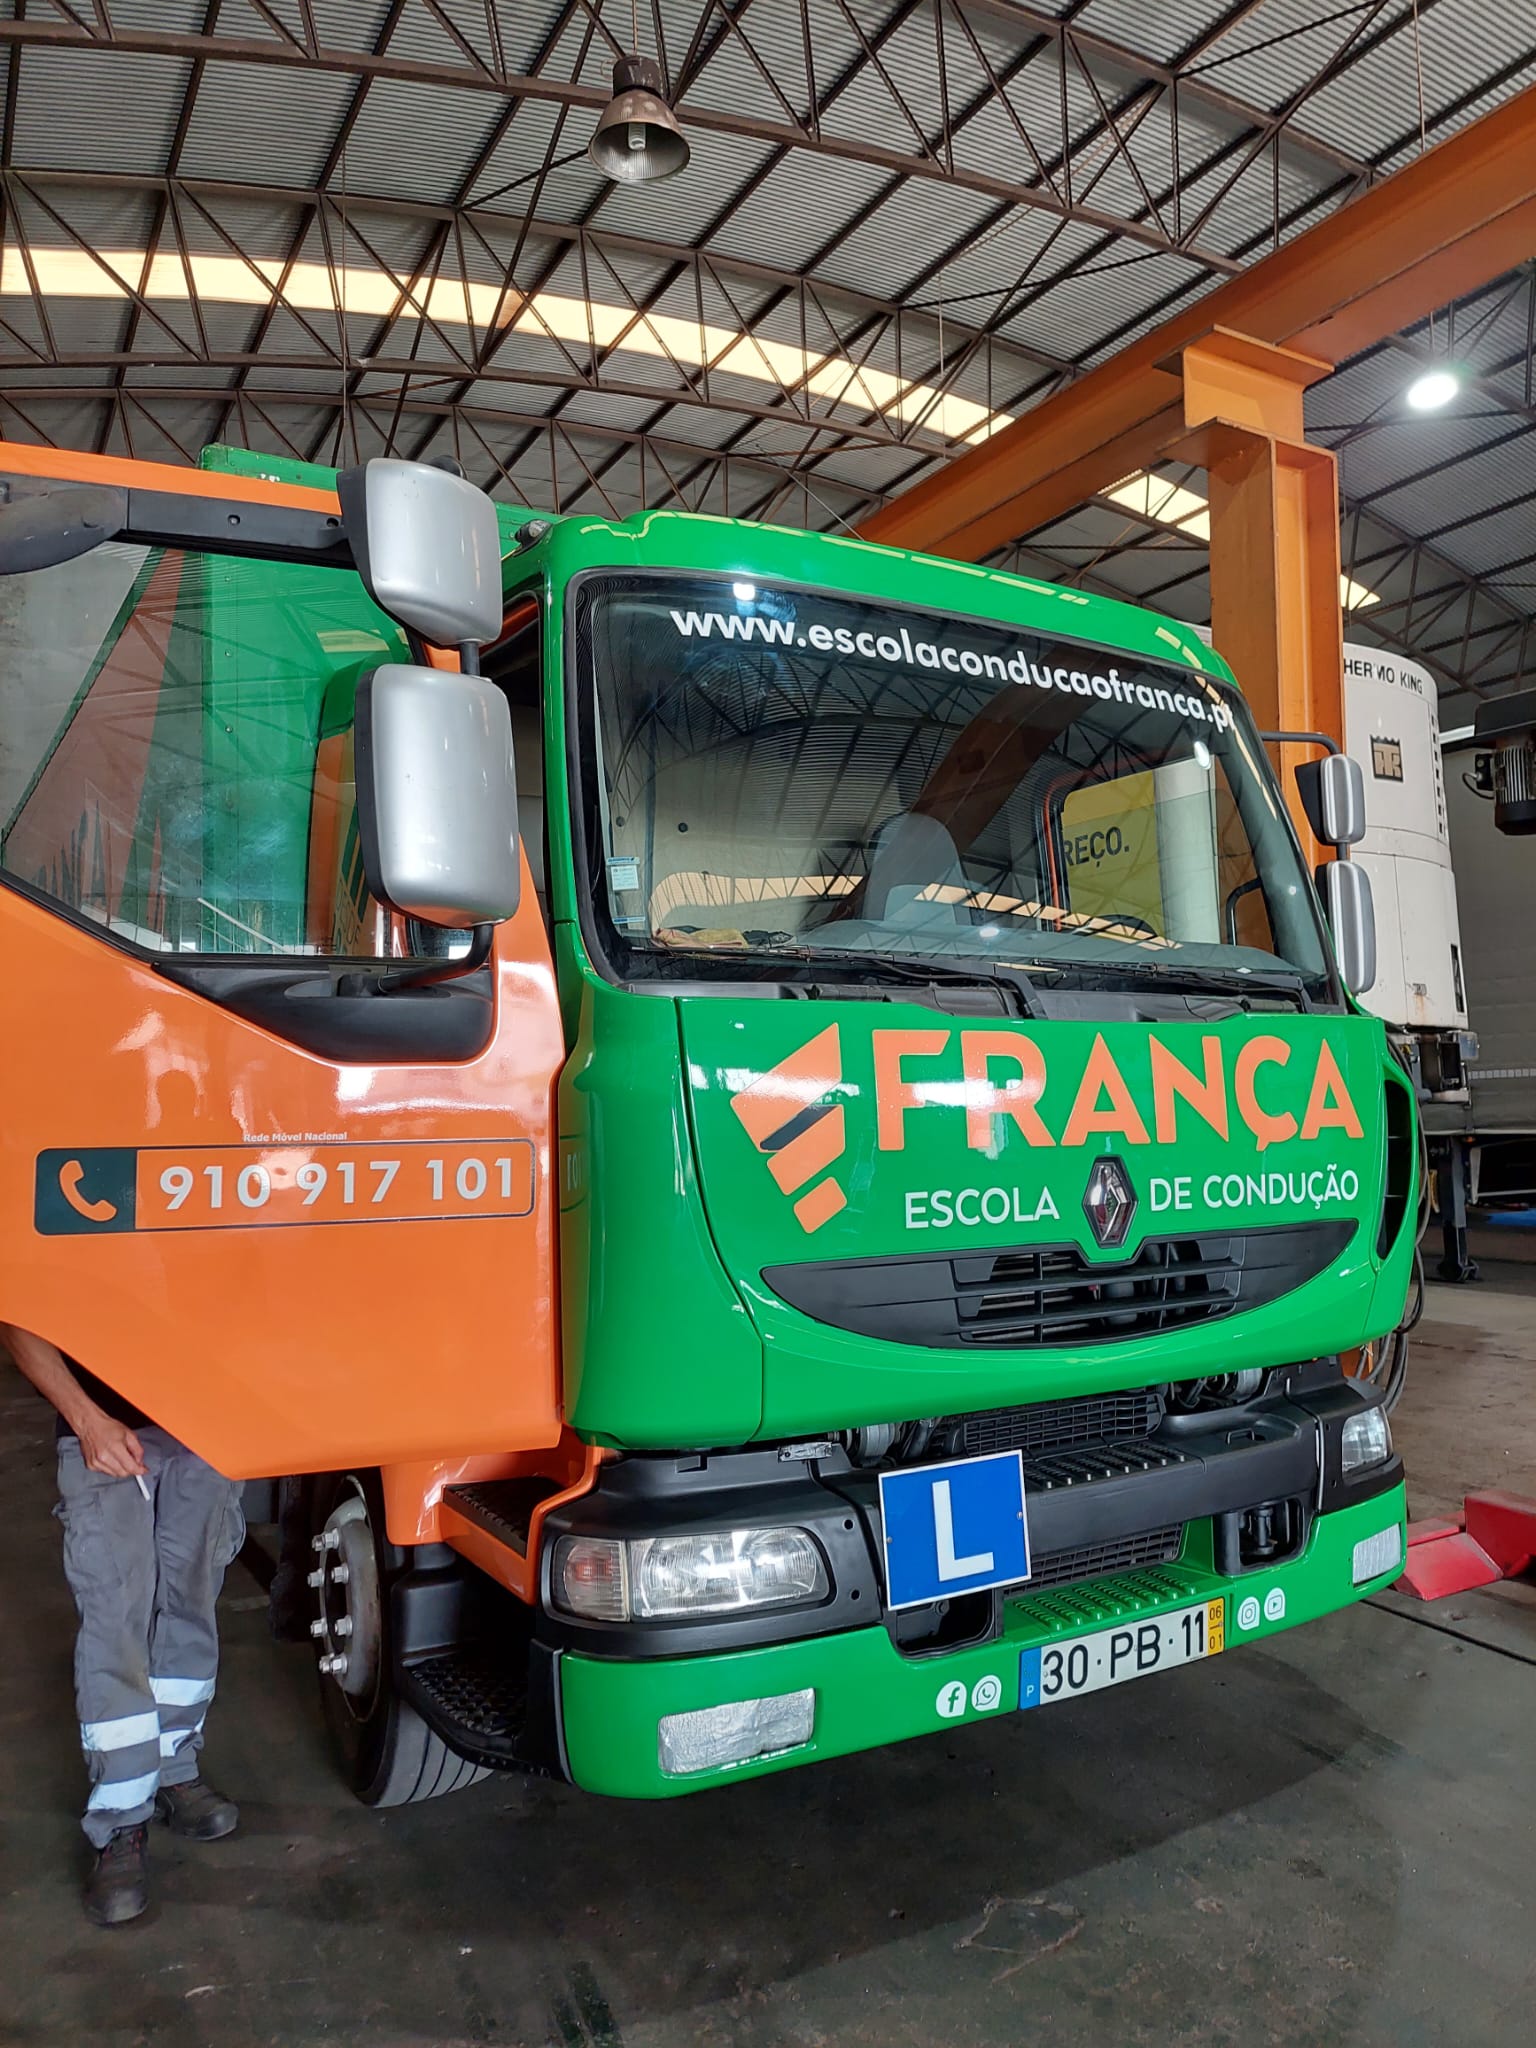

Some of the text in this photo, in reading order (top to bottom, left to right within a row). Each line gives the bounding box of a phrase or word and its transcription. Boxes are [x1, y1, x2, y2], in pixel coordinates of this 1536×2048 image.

[669, 610, 1236, 733] www.escolaconducaofranca.pt
[1400, 670, 1423, 695] KING
[1064, 826, 1129, 868] REÇO.
[872, 1029, 1365, 1152] FRANÇA
[243, 1131, 348, 1142] Rede Móvel Nacional
[159, 1157, 512, 1211] 910 917 101
[904, 1162, 1359, 1229] ESCOLA DE CONDUÇÃO
[932, 1479, 994, 1582] L
[1209, 1605, 1222, 1621] 06
[1209, 1633, 1222, 1650] 01
[1026, 1684, 1035, 1698] P
